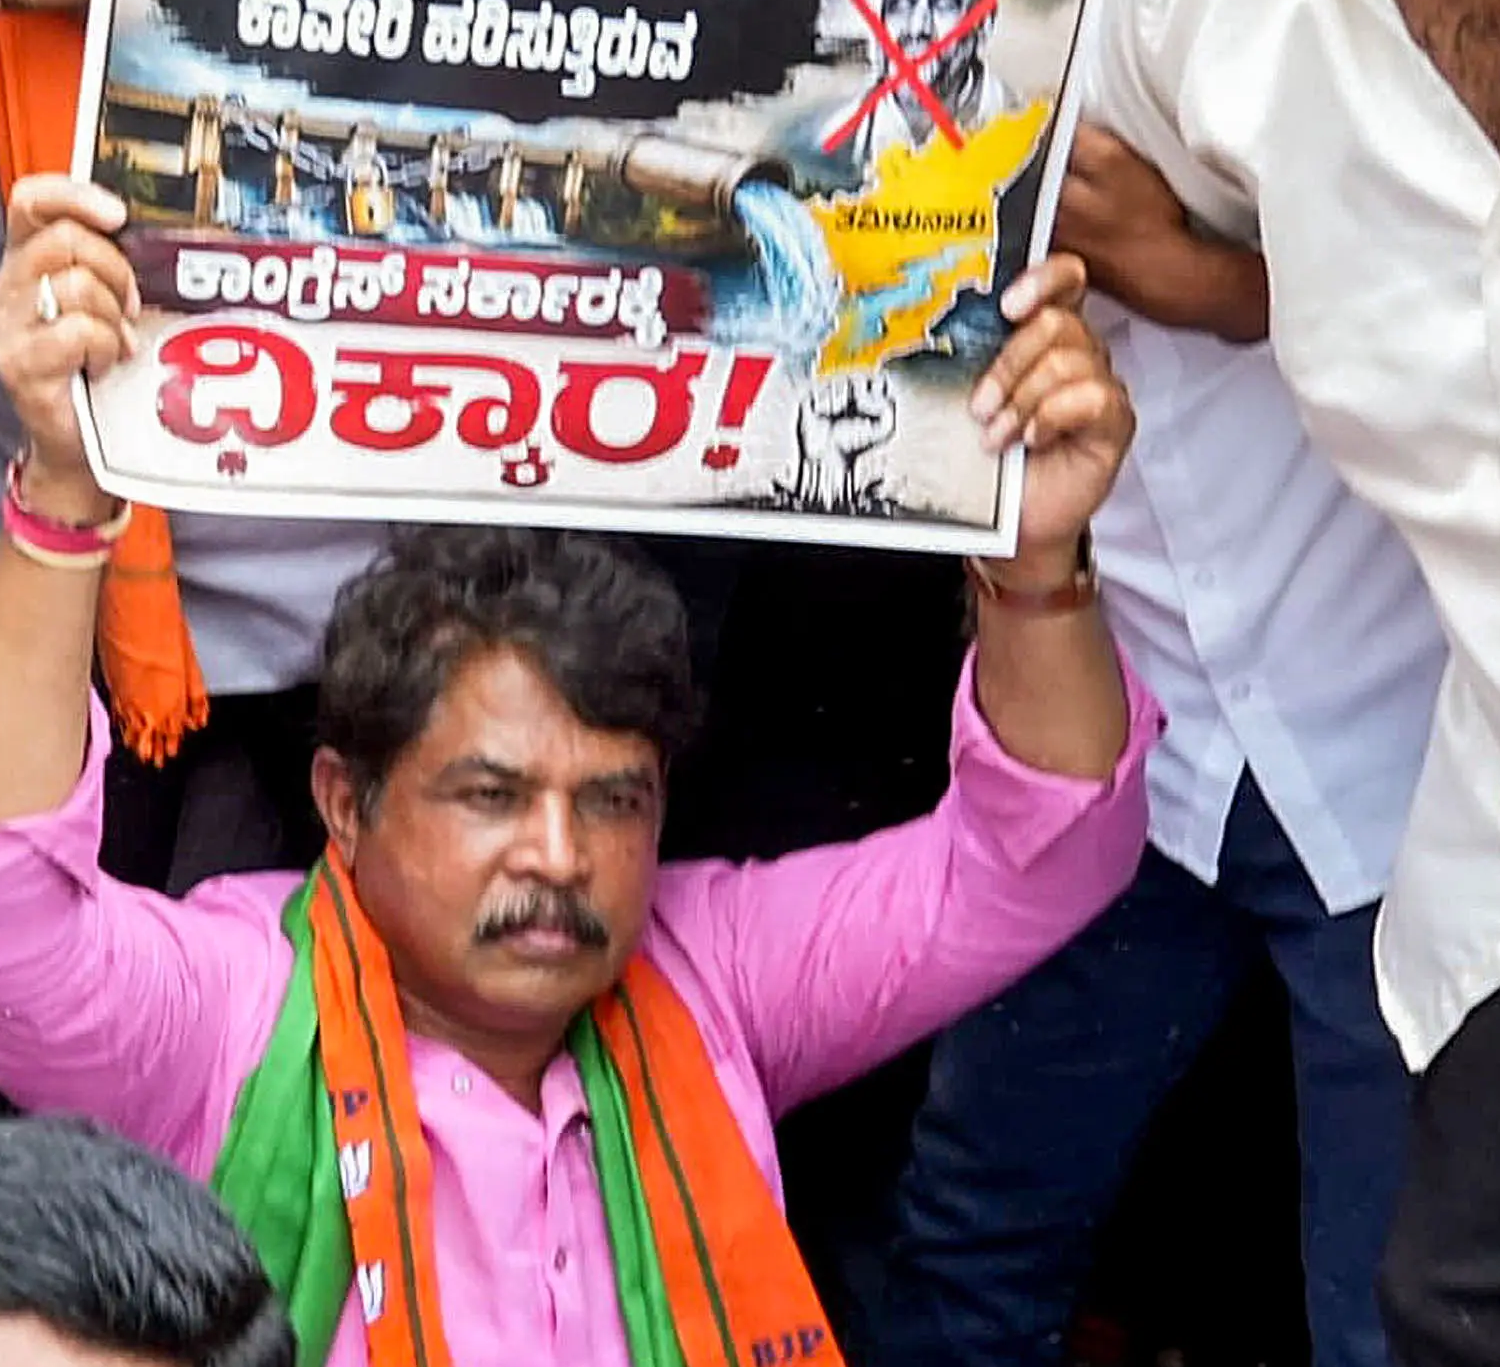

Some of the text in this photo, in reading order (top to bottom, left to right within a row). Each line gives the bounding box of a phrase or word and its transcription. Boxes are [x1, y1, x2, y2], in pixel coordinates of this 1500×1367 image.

[175, 245, 668, 349] ಕಾಂಗ್ರೆಸ್ ಸರ್ಕಾರಕ್ಕೆ
[155, 323, 776, 489] ಧಿಕ್ಕಾರ!
